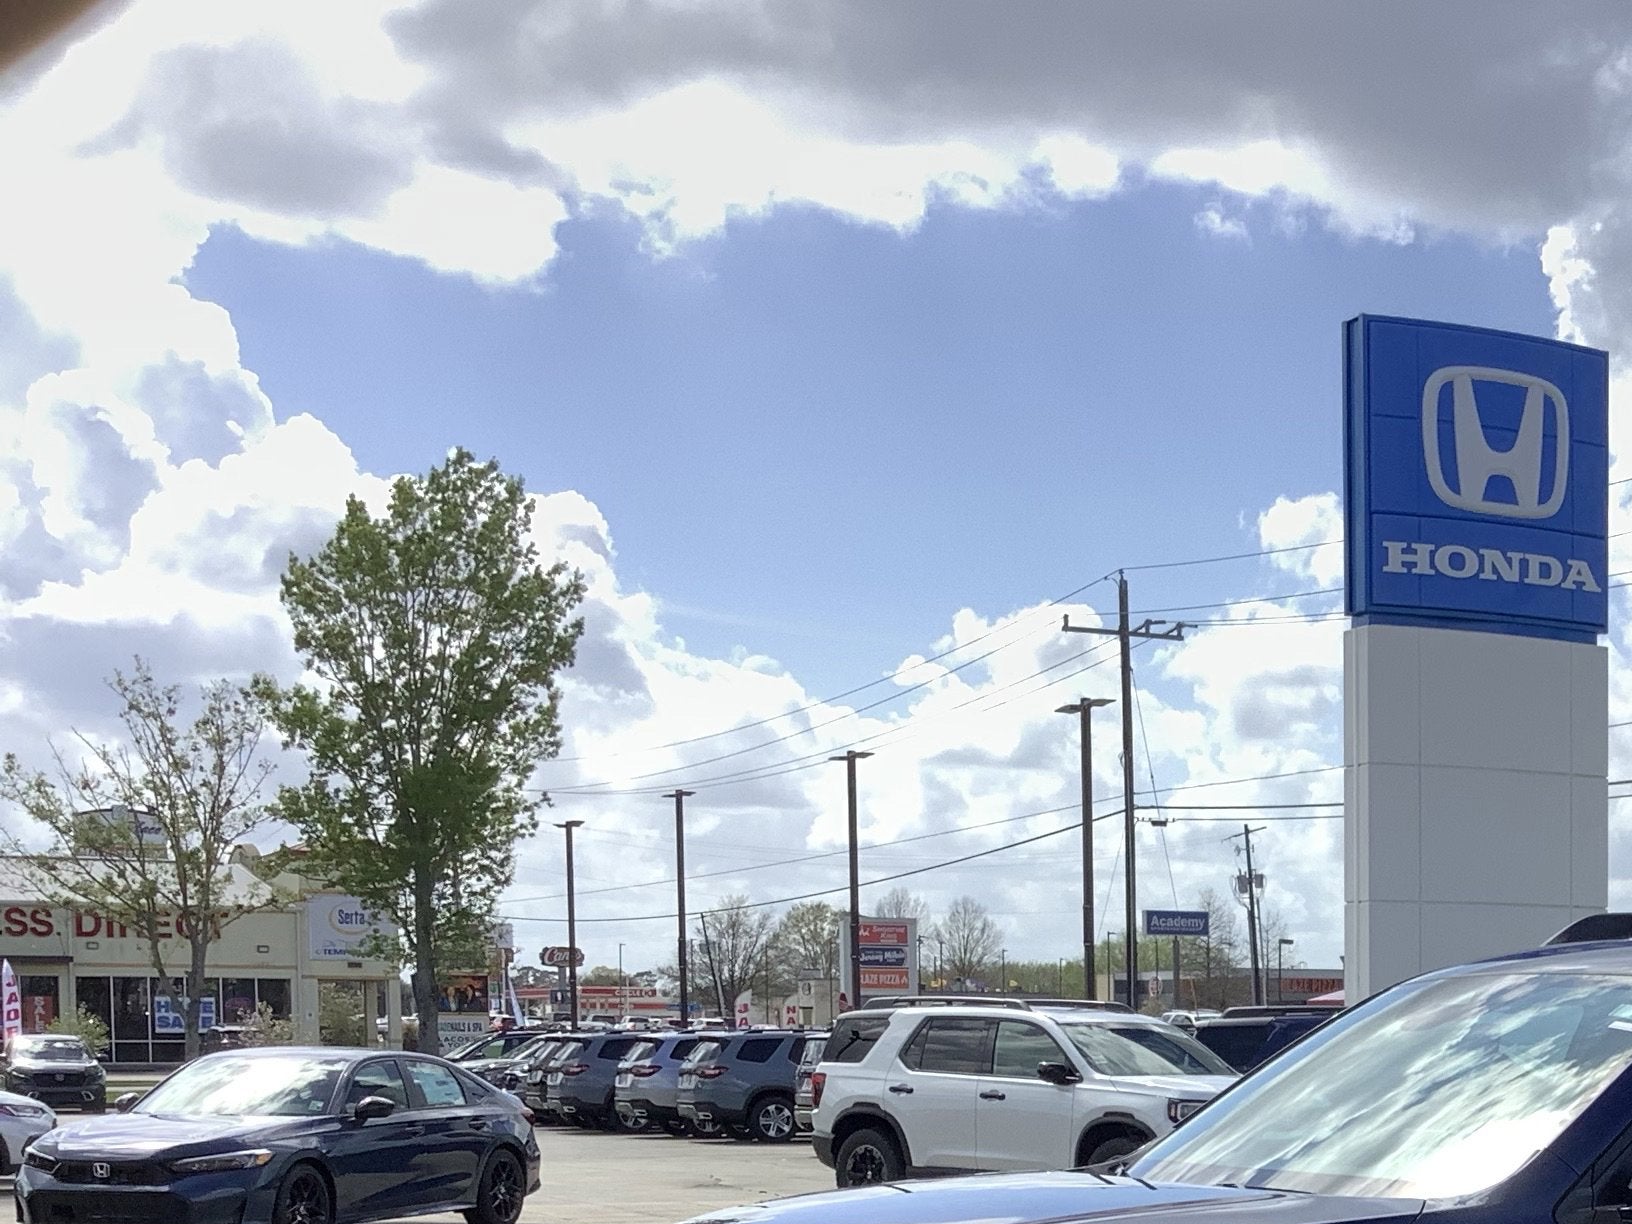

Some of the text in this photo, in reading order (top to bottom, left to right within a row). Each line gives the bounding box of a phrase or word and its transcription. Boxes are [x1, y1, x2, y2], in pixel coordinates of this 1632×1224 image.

[1382, 541, 1601, 592] HONDA
[338, 909, 365, 925] Serta
[1151, 915, 1206, 931] Academy
[879, 974, 899, 985] PIZZA
[34, 997, 45, 1032] SALE
[157, 1015, 213, 1029] SAE
